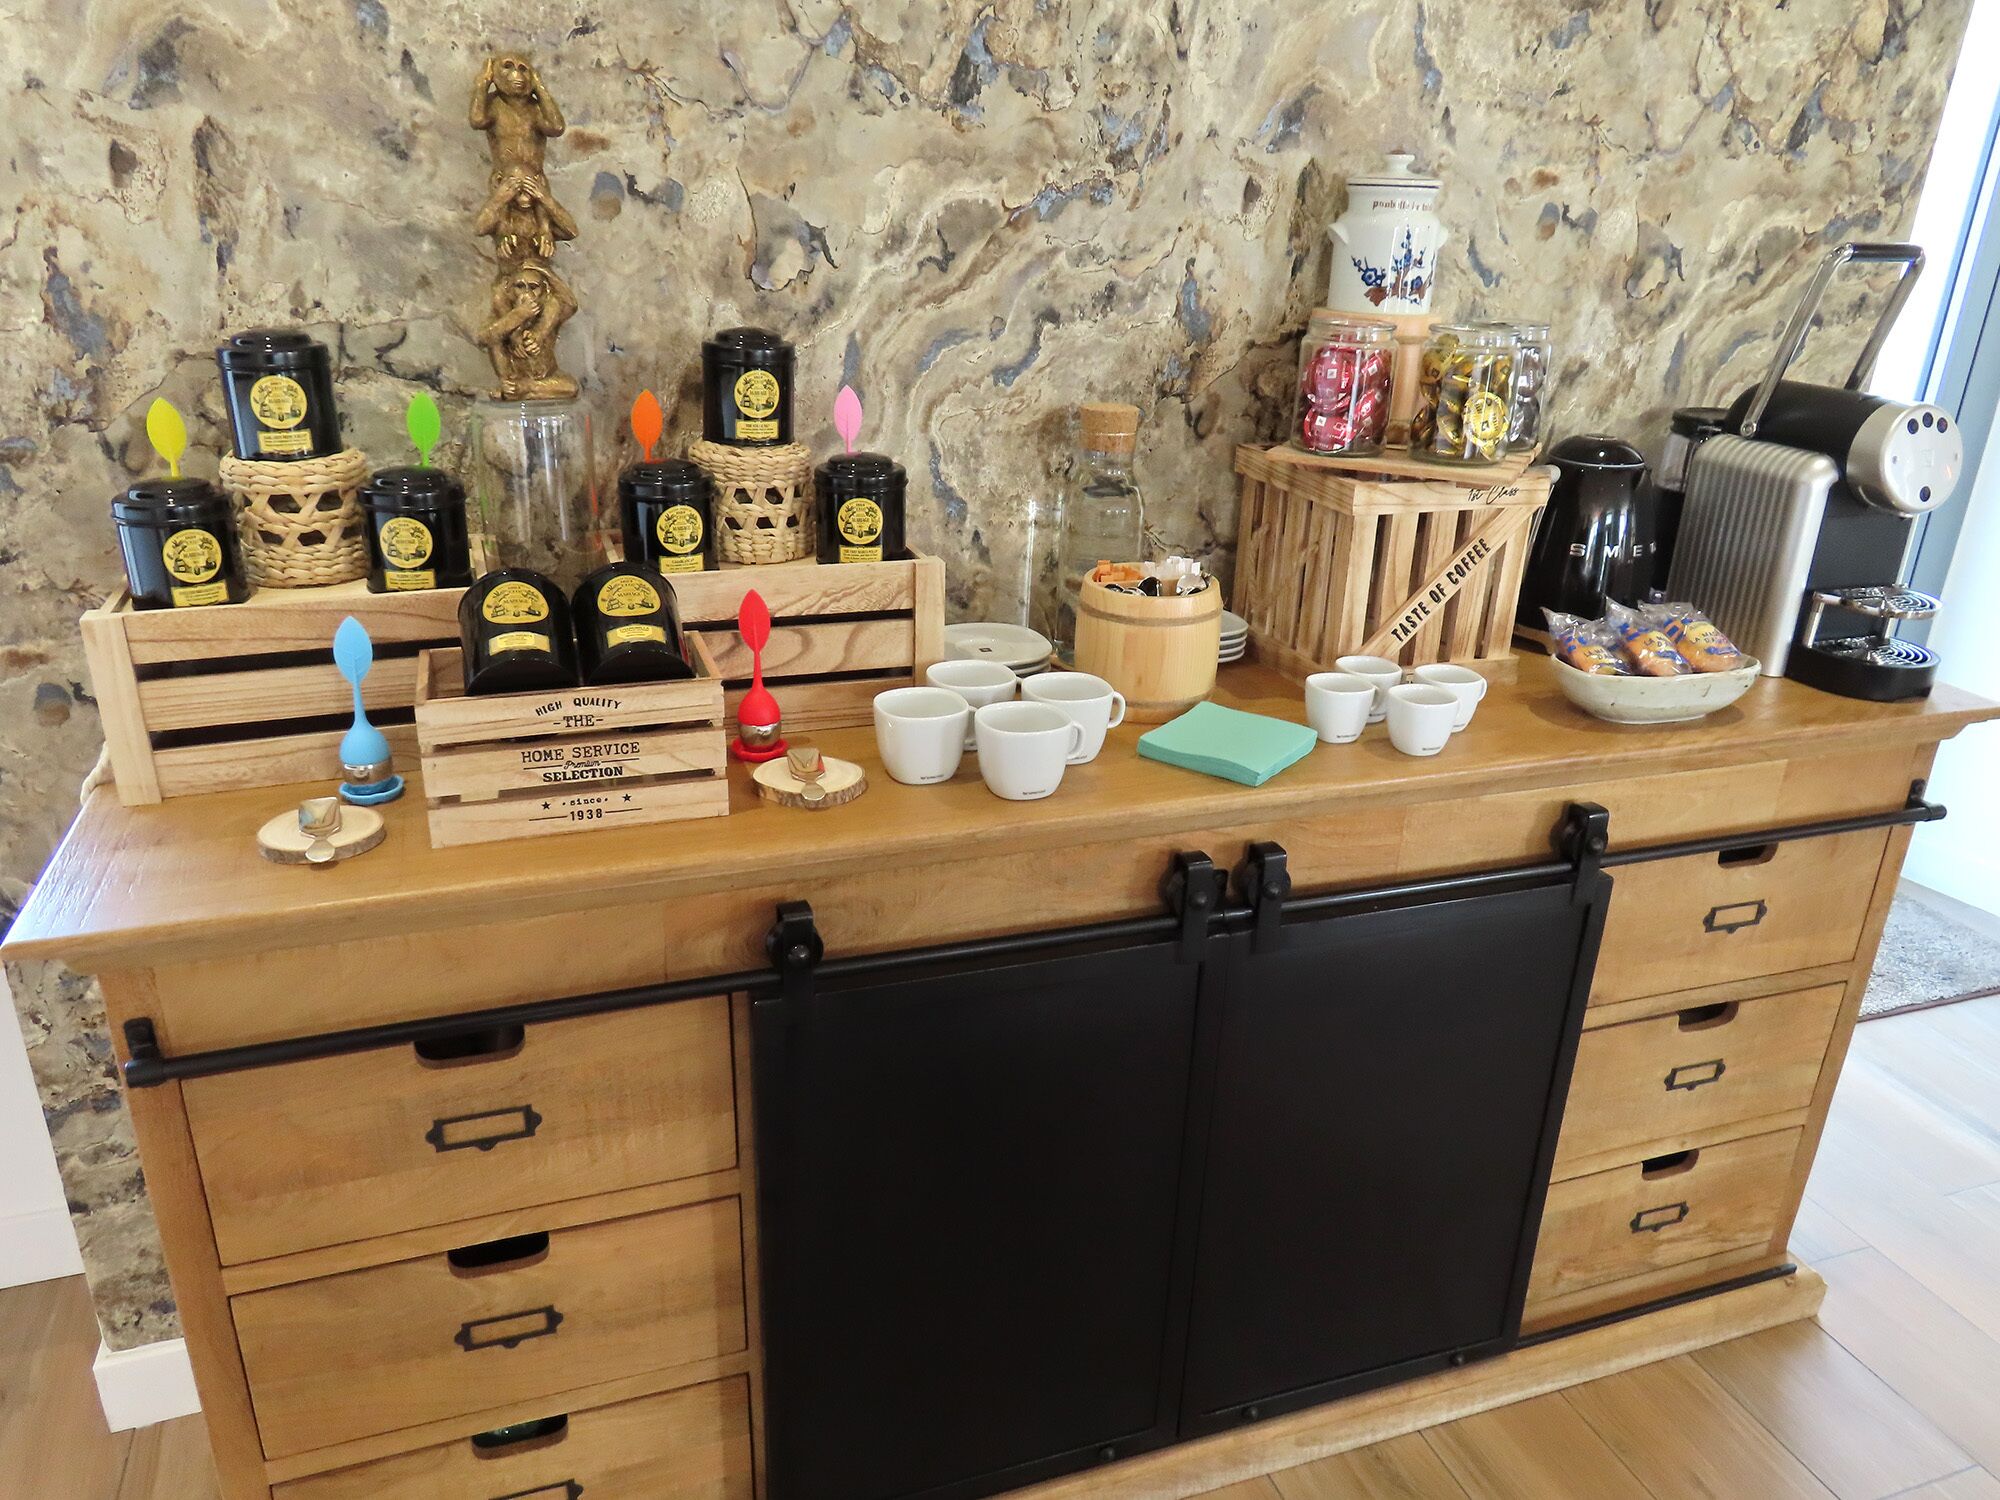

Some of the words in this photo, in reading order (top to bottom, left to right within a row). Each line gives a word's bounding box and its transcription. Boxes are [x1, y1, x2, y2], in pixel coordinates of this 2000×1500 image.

[1391, 601, 1431, 643] TASTE
[1428, 582, 1447, 605] OF
[1445, 537, 1491, 586] COFFEE
[535, 700, 563, 716] HIGH
[573, 697, 622, 709] QUALITY
[521, 748, 565, 763] HOME
[572, 741, 640, 759] SERVICE
[563, 759, 601, 770] Premium
[542, 766, 623, 783] SELECTION
[570, 797, 602, 806] since
[570, 808, 603, 821] 1938
